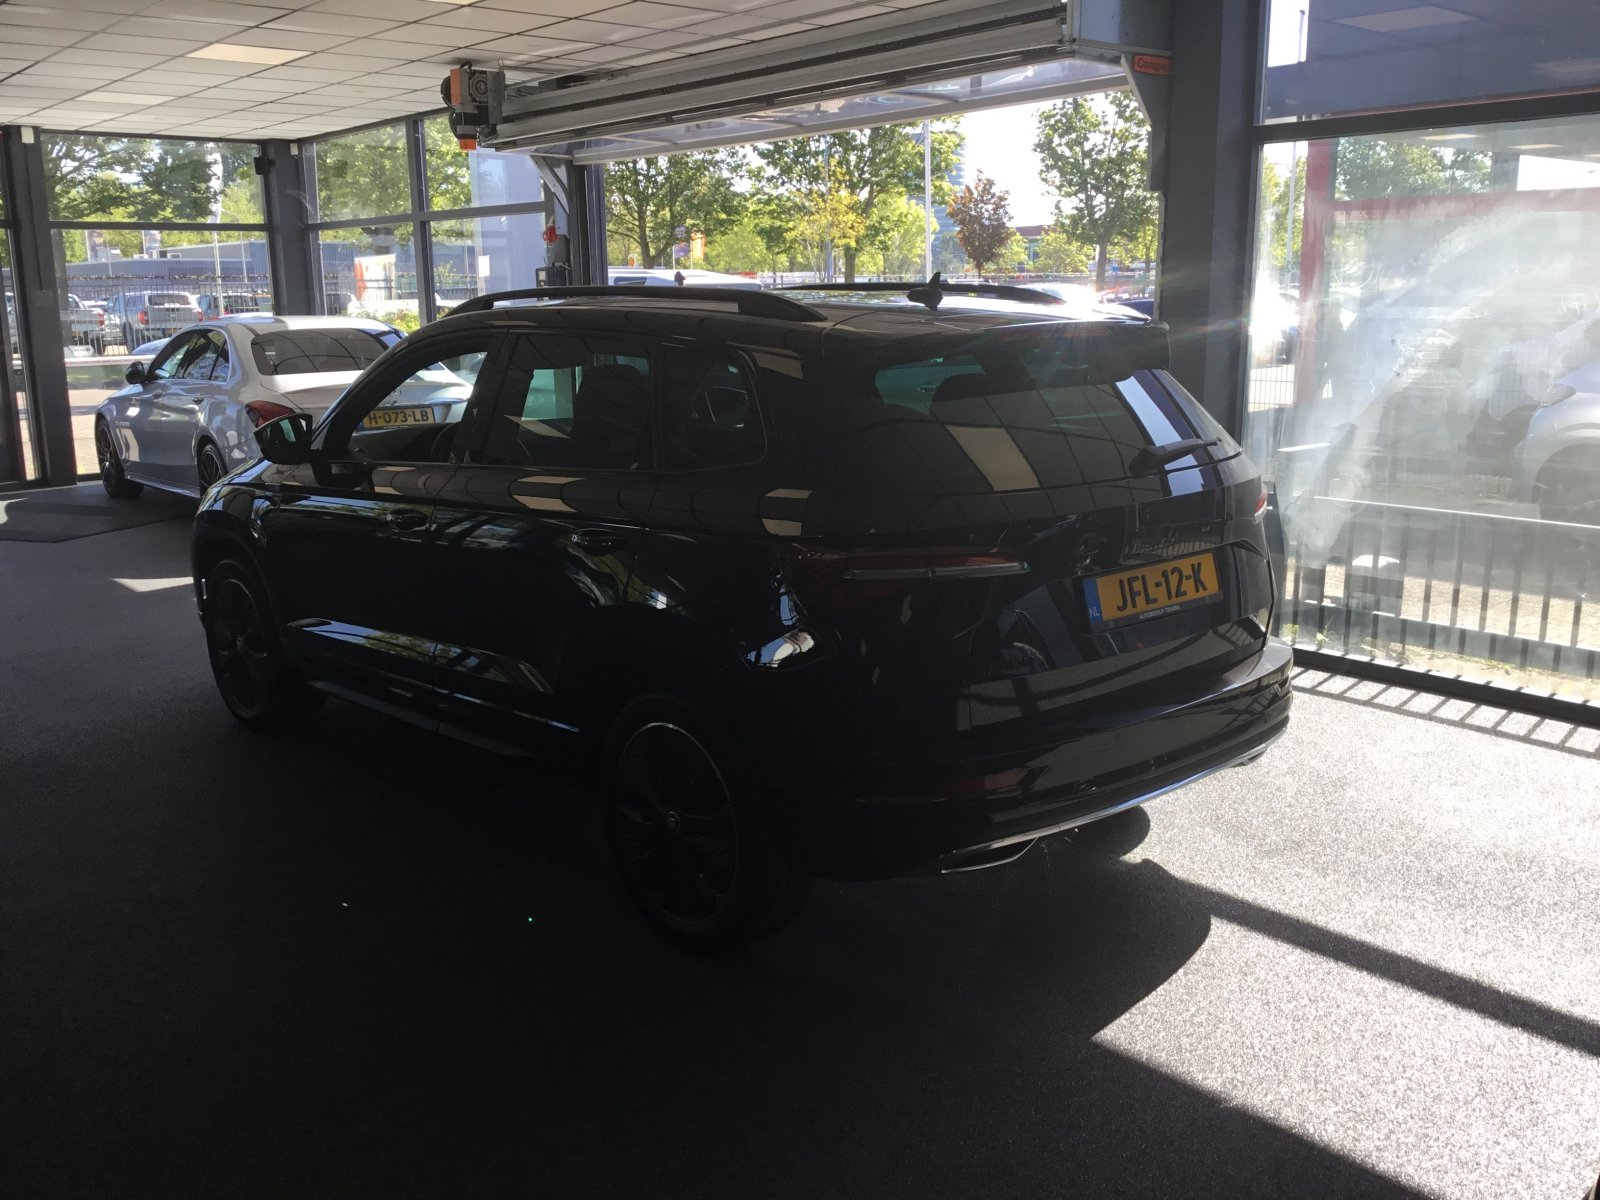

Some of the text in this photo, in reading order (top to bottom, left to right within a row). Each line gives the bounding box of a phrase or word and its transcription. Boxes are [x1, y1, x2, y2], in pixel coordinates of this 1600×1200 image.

[367, 409, 430, 426] H-073-LB
[1116, 562, 1208, 612] JFL-12-K
[1088, 606, 1101, 618] NL
